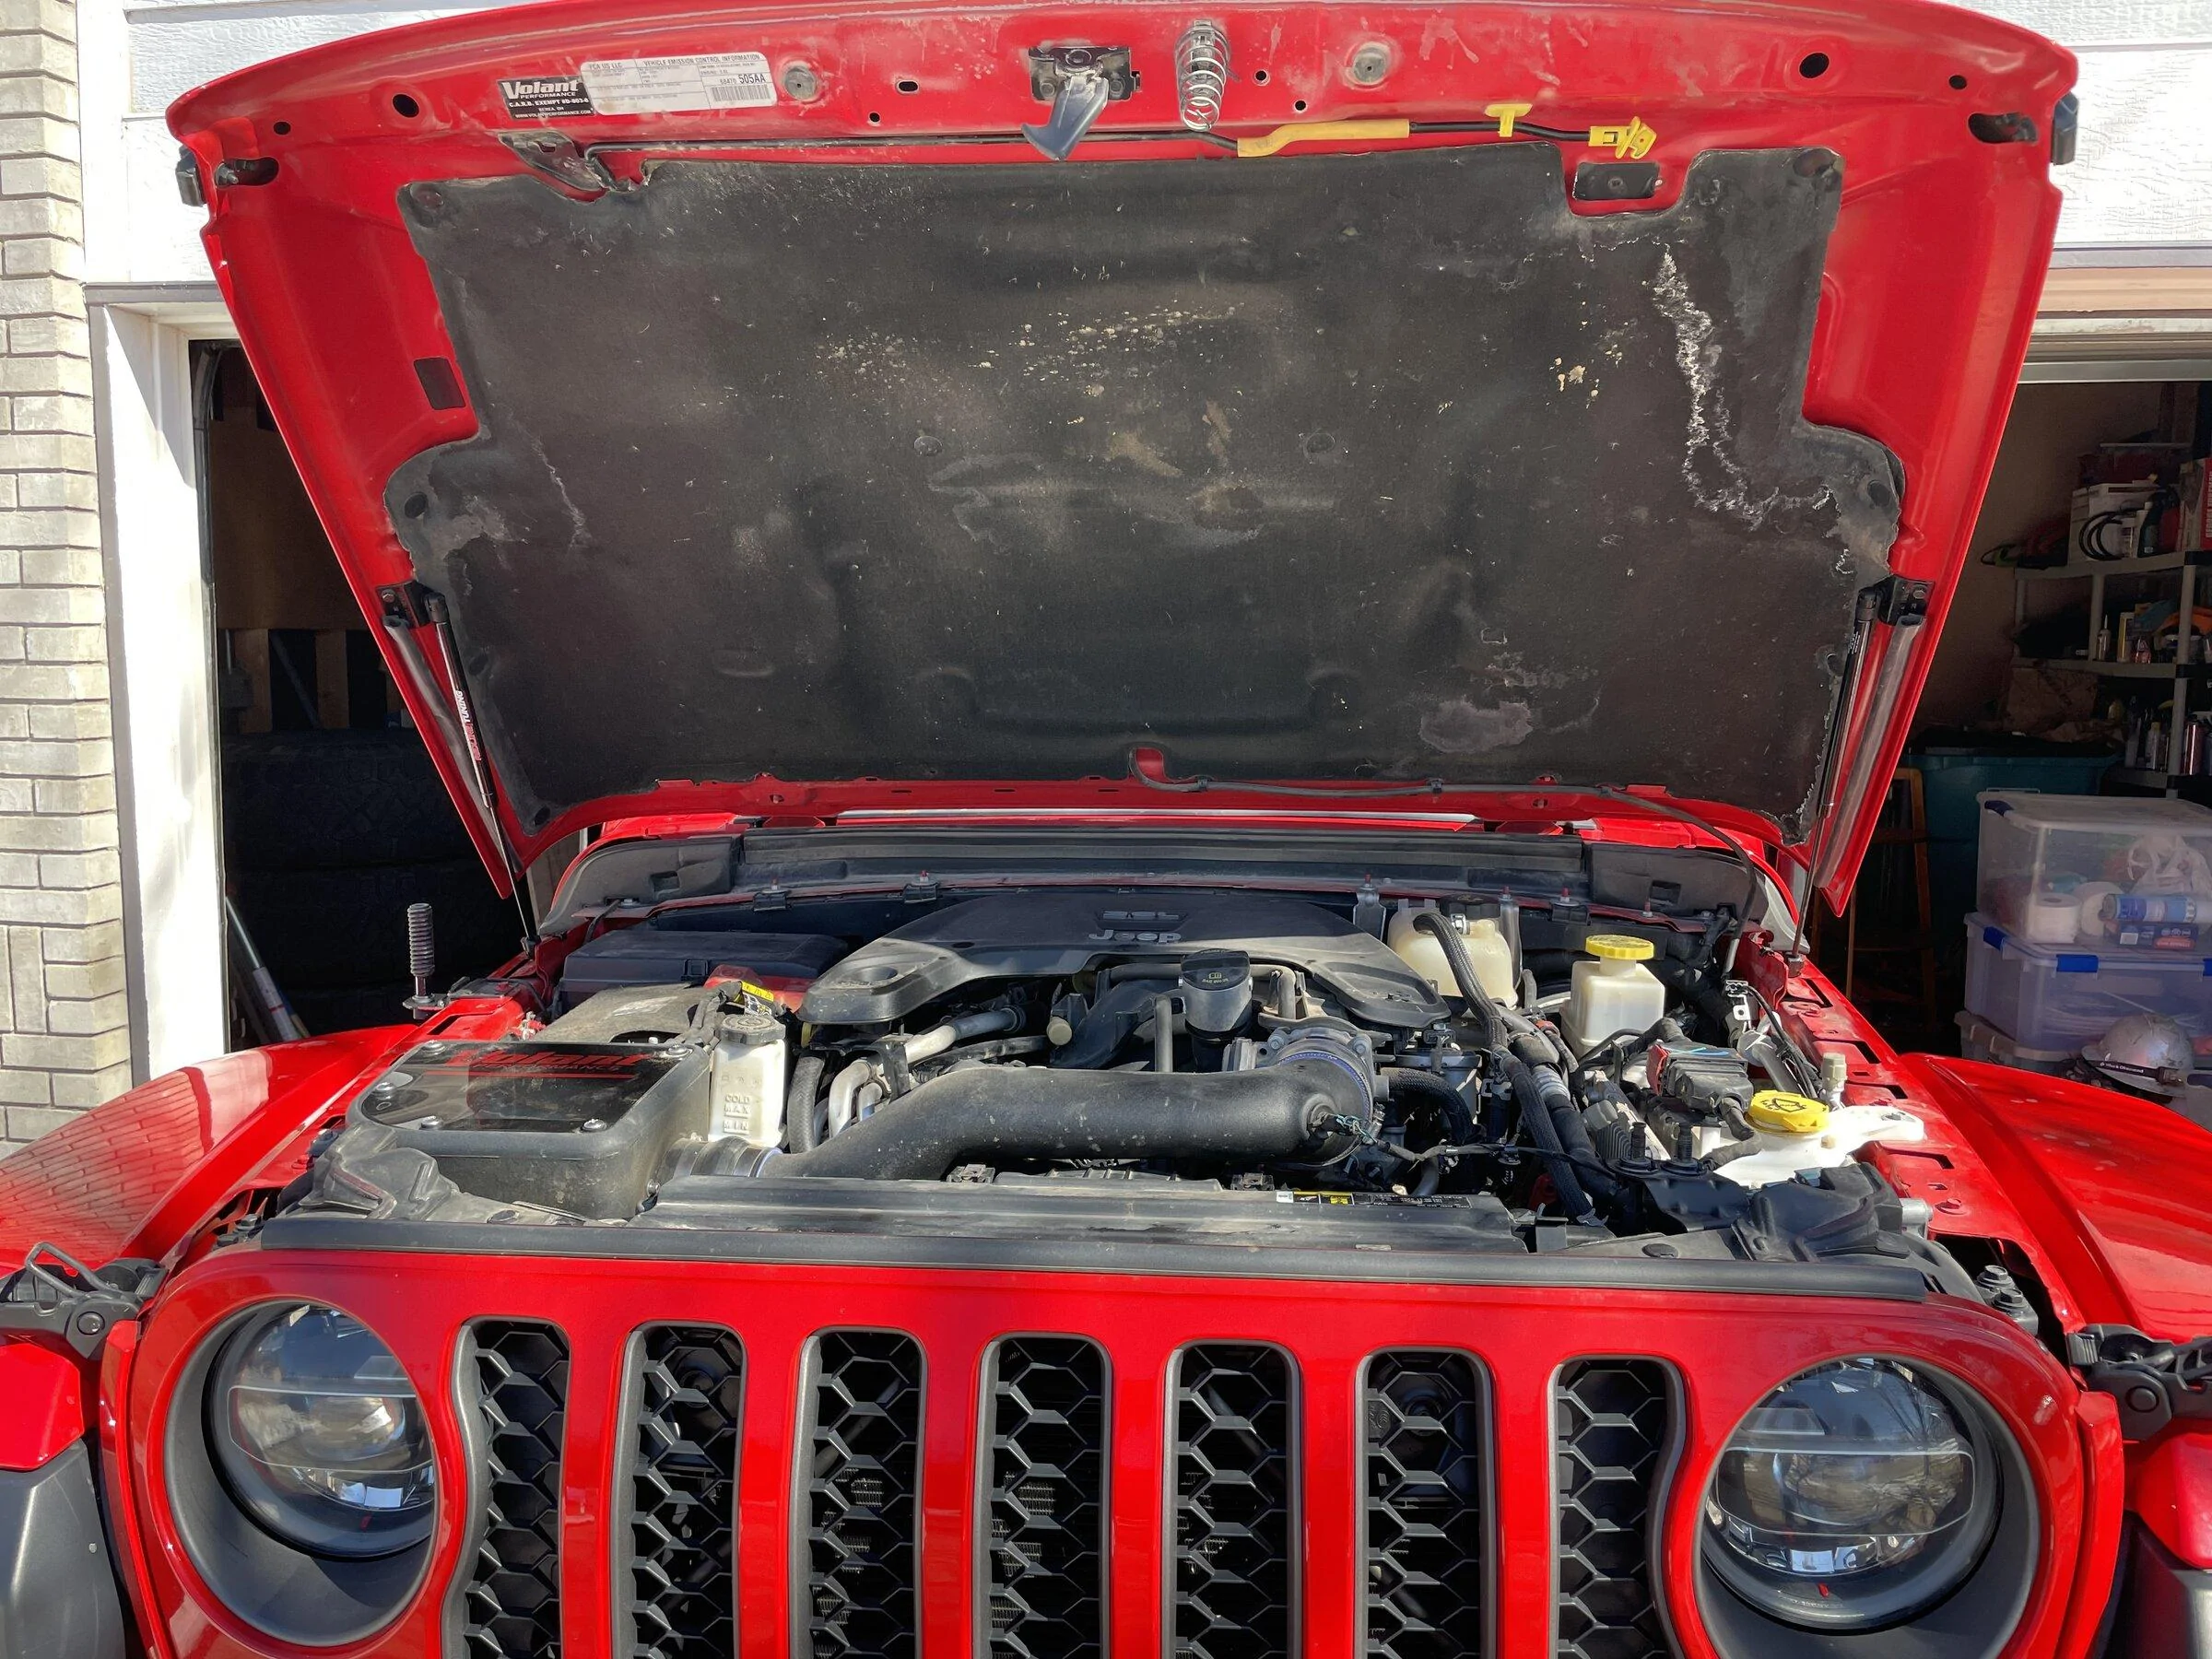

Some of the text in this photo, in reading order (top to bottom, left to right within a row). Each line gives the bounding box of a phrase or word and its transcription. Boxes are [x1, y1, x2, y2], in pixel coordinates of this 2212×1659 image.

[738, 74, 766, 84] 505AA
[501, 79, 579, 100] Volant
[455, 689, 471, 724] TUNING
[1088, 929, 1182, 943] Jeep
[725, 1094, 750, 1104] COLD
[724, 1103, 748, 1114] MAX
[723, 1119, 747, 1131] MIN
